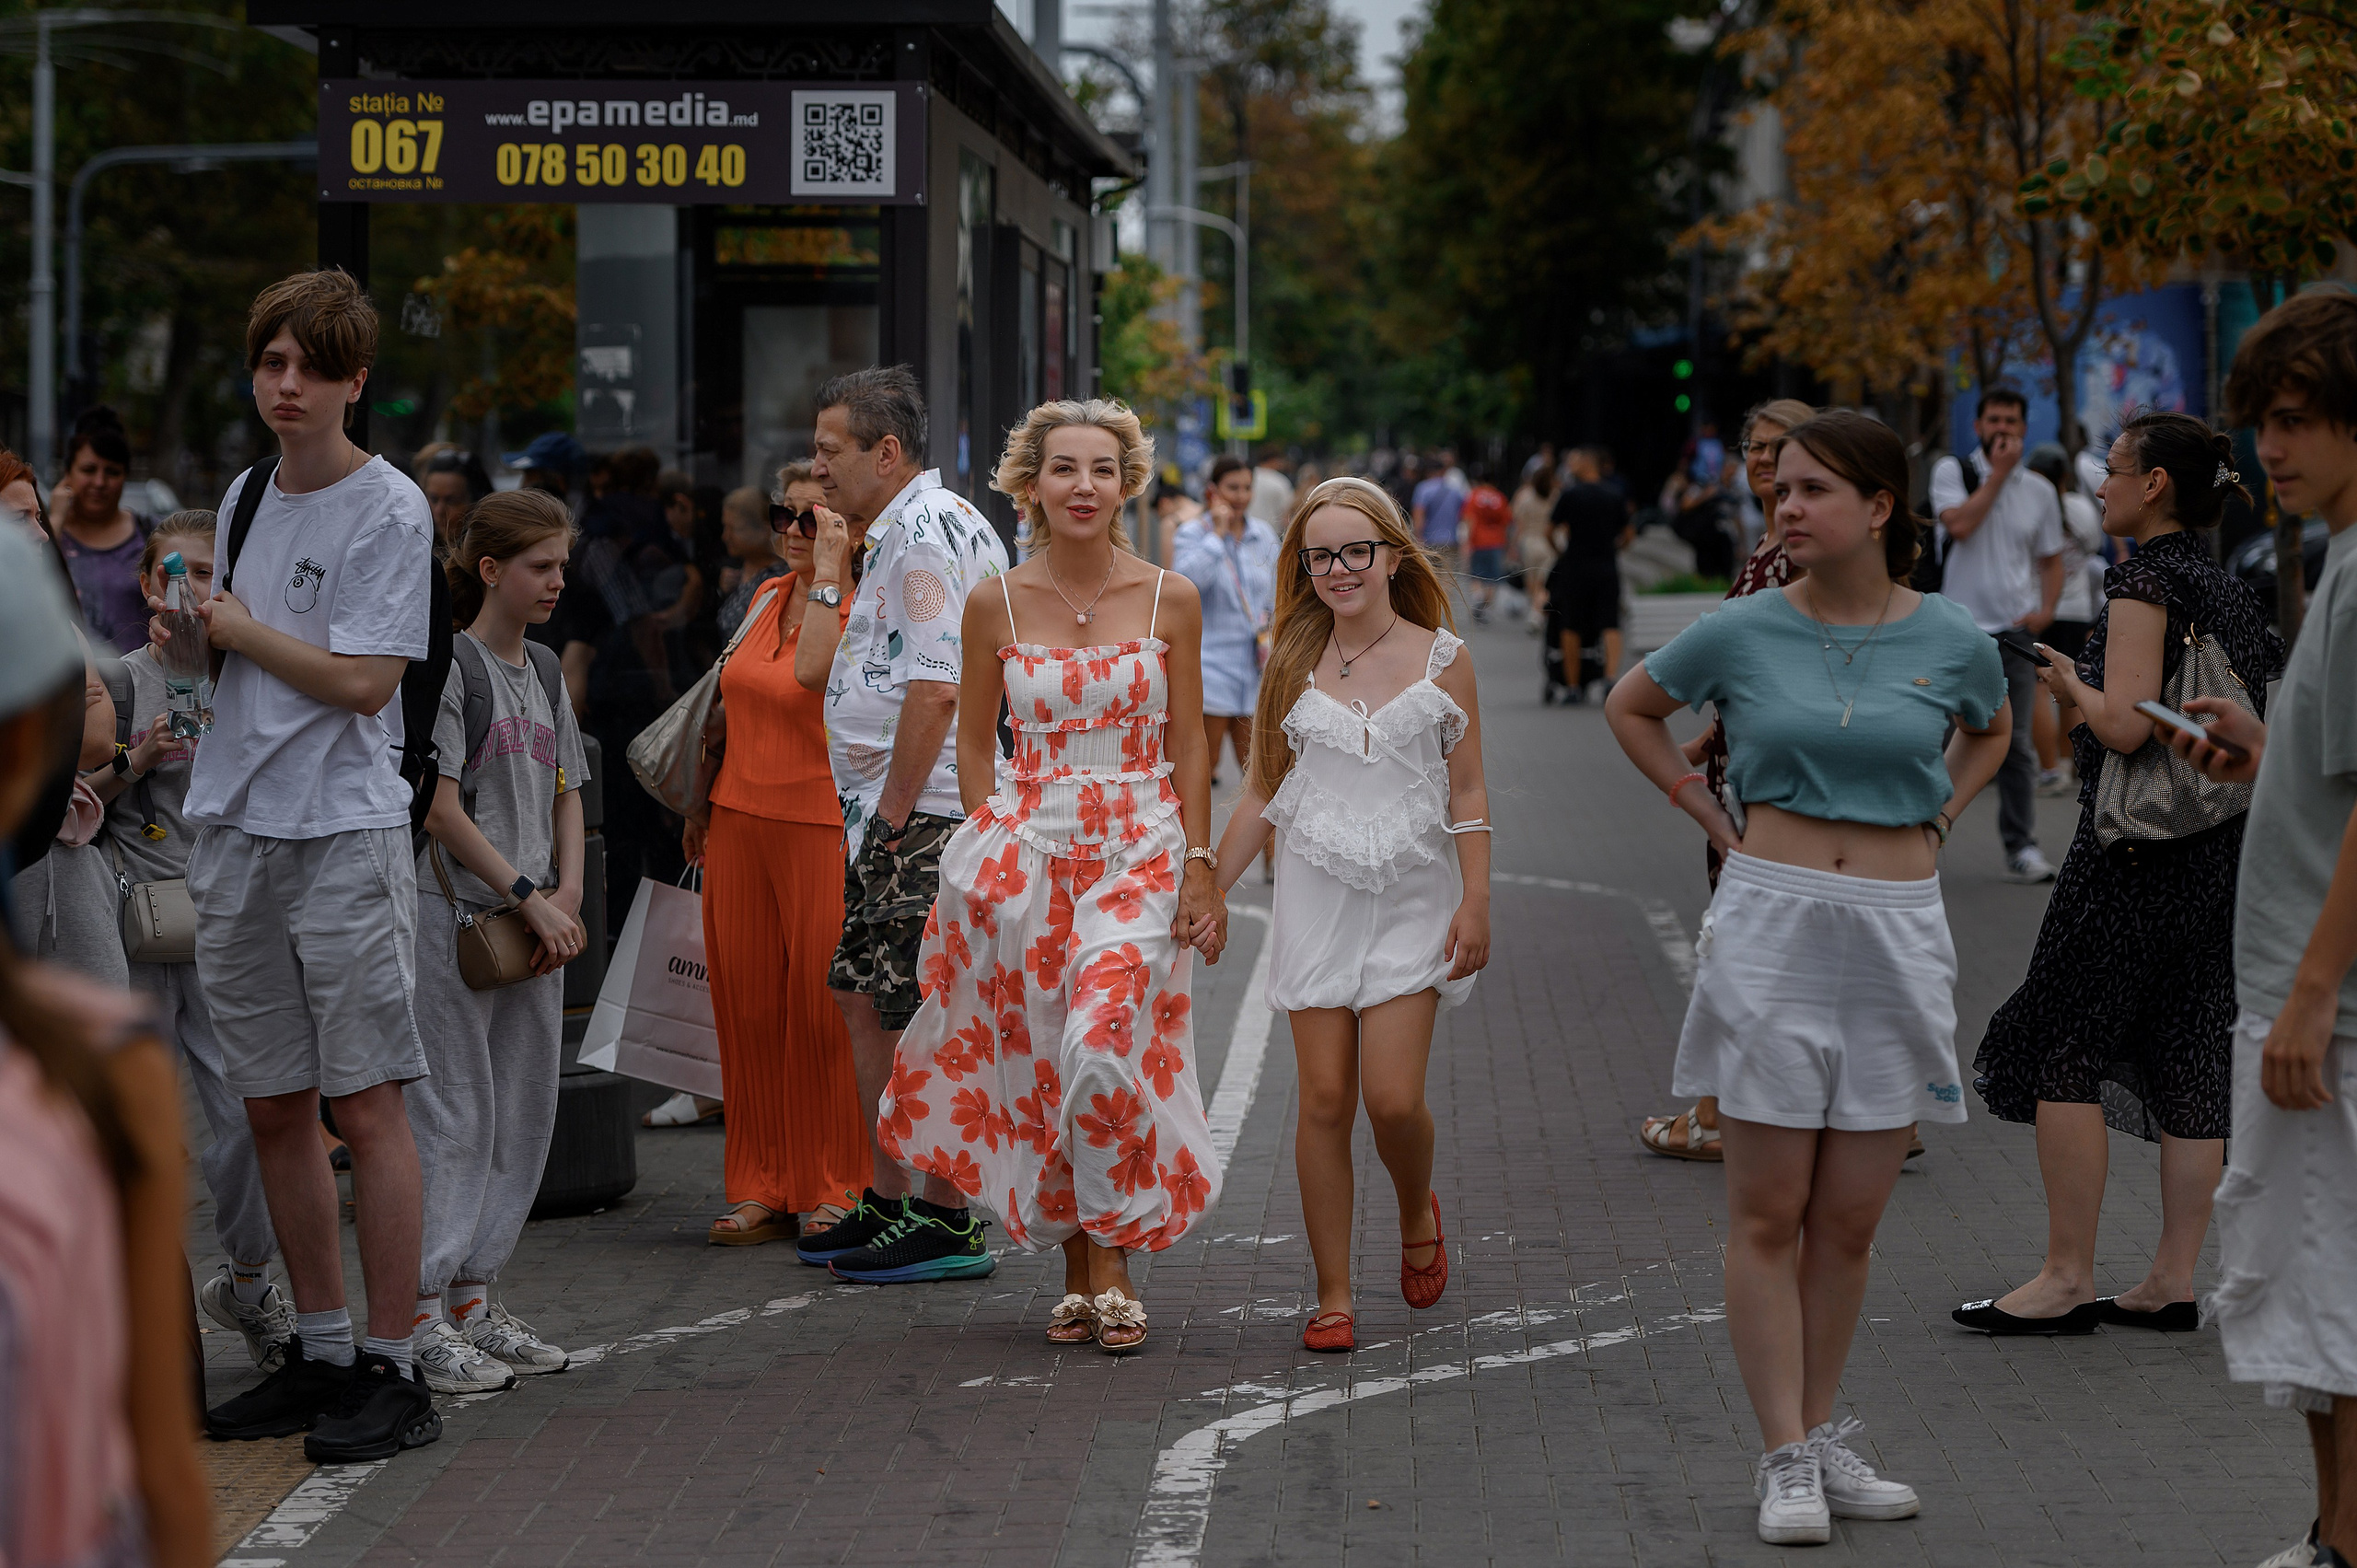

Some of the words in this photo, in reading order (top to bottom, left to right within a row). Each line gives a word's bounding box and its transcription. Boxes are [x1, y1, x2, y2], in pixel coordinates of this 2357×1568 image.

[484, 92, 759, 134] www.epamedia.md
[350, 118, 445, 175] 067
[495, 143, 567, 186] 078
[575, 143, 628, 186] 50
[635, 143, 688, 186] 30
[694, 143, 747, 187] 40
[348, 178, 424, 191] остановка
